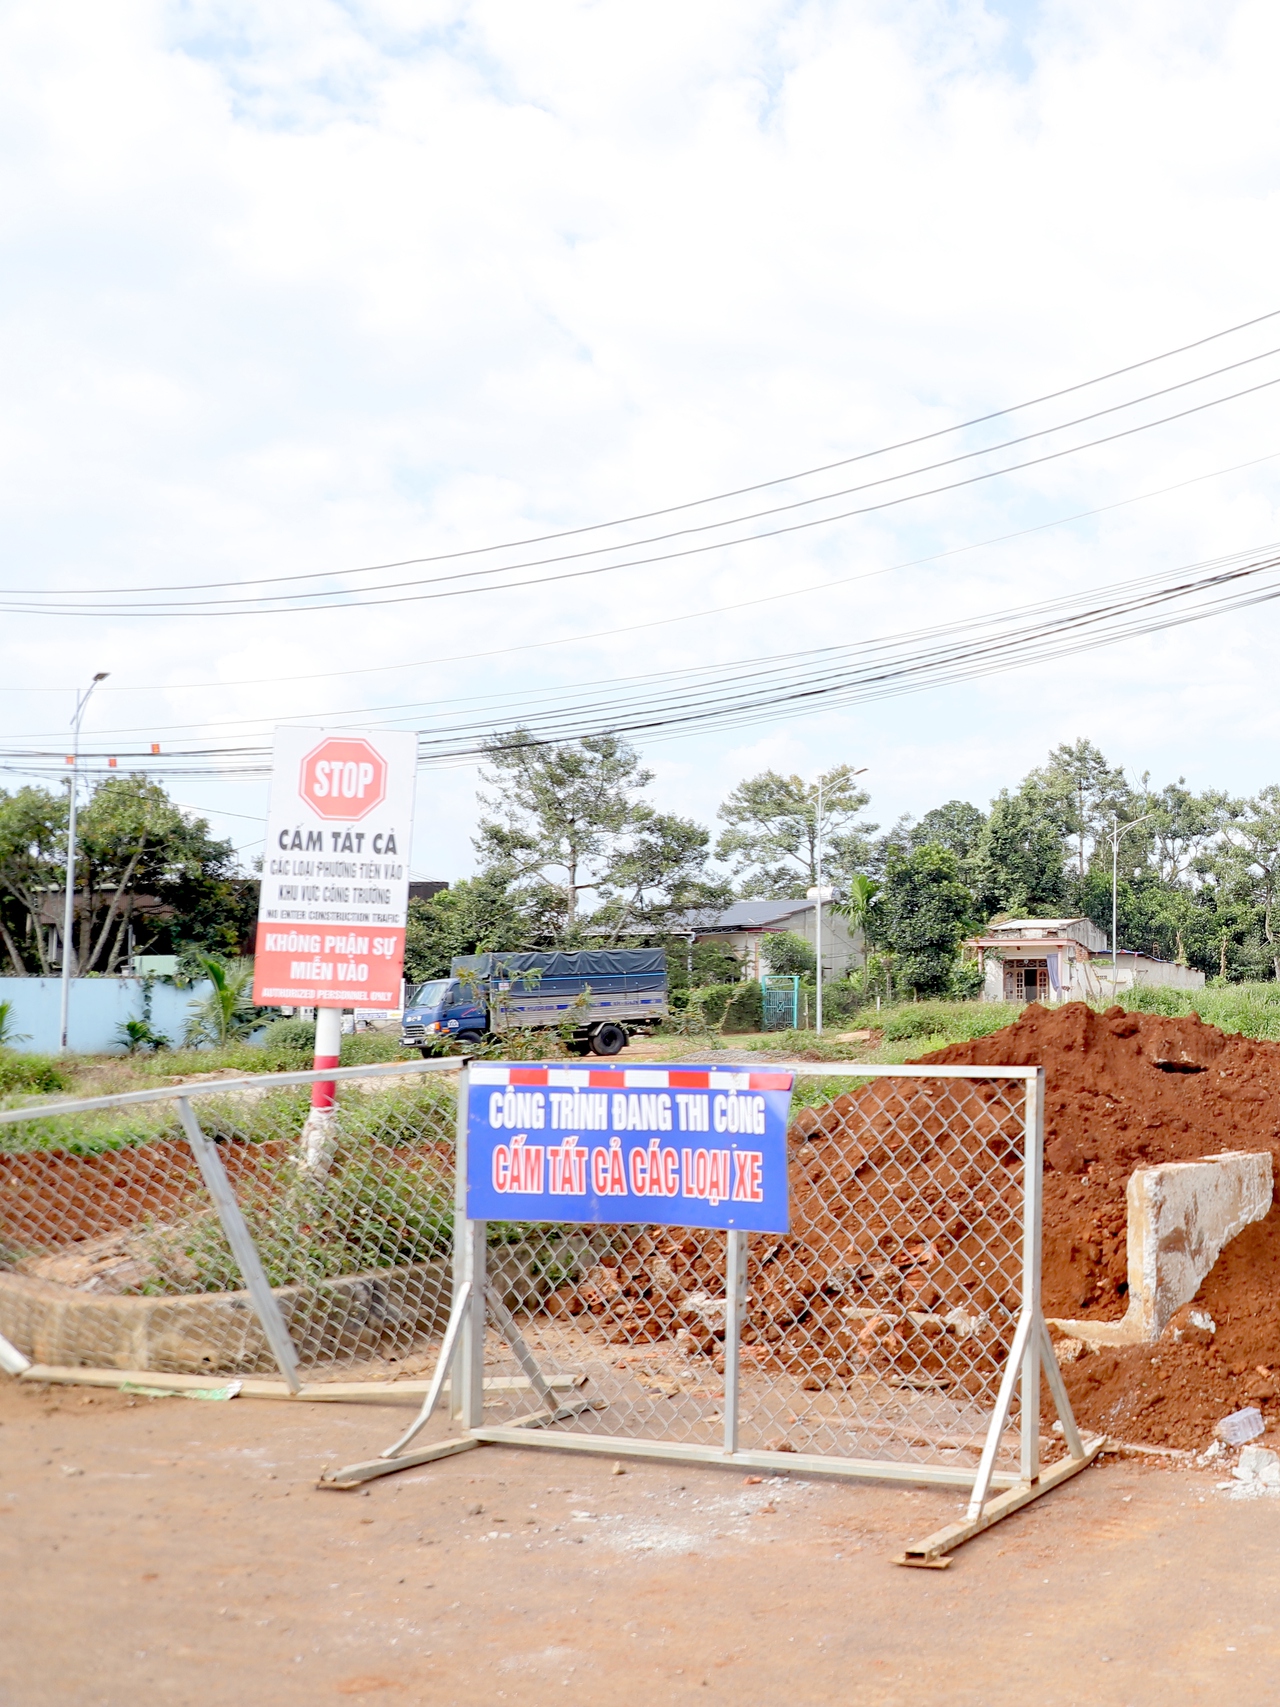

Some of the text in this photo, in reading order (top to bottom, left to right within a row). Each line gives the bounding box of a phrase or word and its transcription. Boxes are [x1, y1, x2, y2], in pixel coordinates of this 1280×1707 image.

[313, 760, 375, 798] STOP
[279, 823, 398, 855] CẤM TẤT CẢ
[270, 857, 403, 883] CÁC LOẠI PHƯƠNG TIỆN VÀO
[278, 882, 391, 905] KHU VỰC CÔNG TRƯỜNG
[266, 908, 400, 923] NO ENTER CONSTRUCTION TRAFIC
[264, 930, 397, 960] KHÔNG PHẬN SỰ
[290, 955, 369, 982] MIỄN VÀO
[262, 987, 393, 1002] AUTHORIZED PERSONNEL ONLY
[488, 1085, 765, 1135] CÔNG TRÌNH ĐANG THI CÔNG
[491, 1134, 764, 1206] CẤM TẤT CẢ CÁC LOẠI XE
